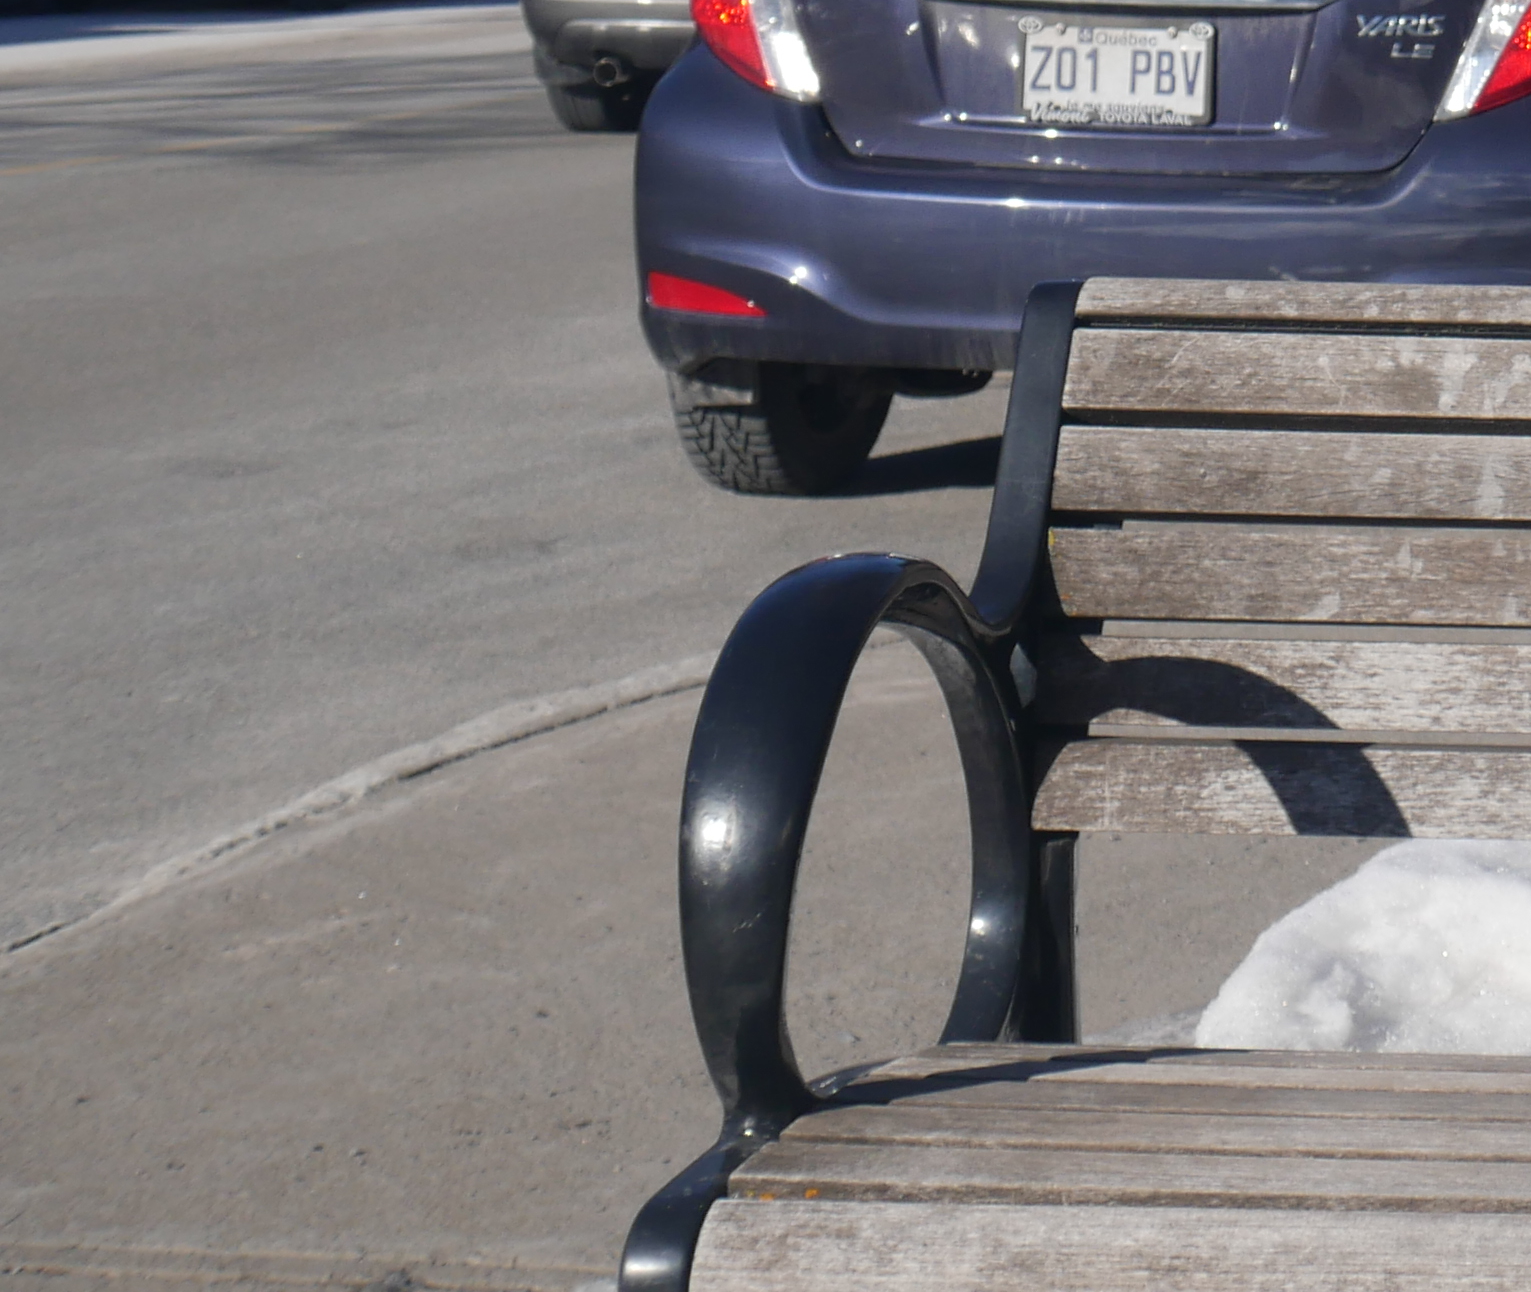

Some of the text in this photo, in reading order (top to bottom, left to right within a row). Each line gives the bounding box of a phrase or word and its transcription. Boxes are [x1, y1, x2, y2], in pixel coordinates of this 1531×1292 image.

[1356, 14, 1446, 37] YARIS
[1095, 30, 1157, 47] Québec
[1390, 42, 1436, 59] LE
[1030, 45, 1203, 97] Z01 PBV
[1099, 111, 1147, 125] TOYOTA
[1151, 112, 1193, 127] LAVAL
